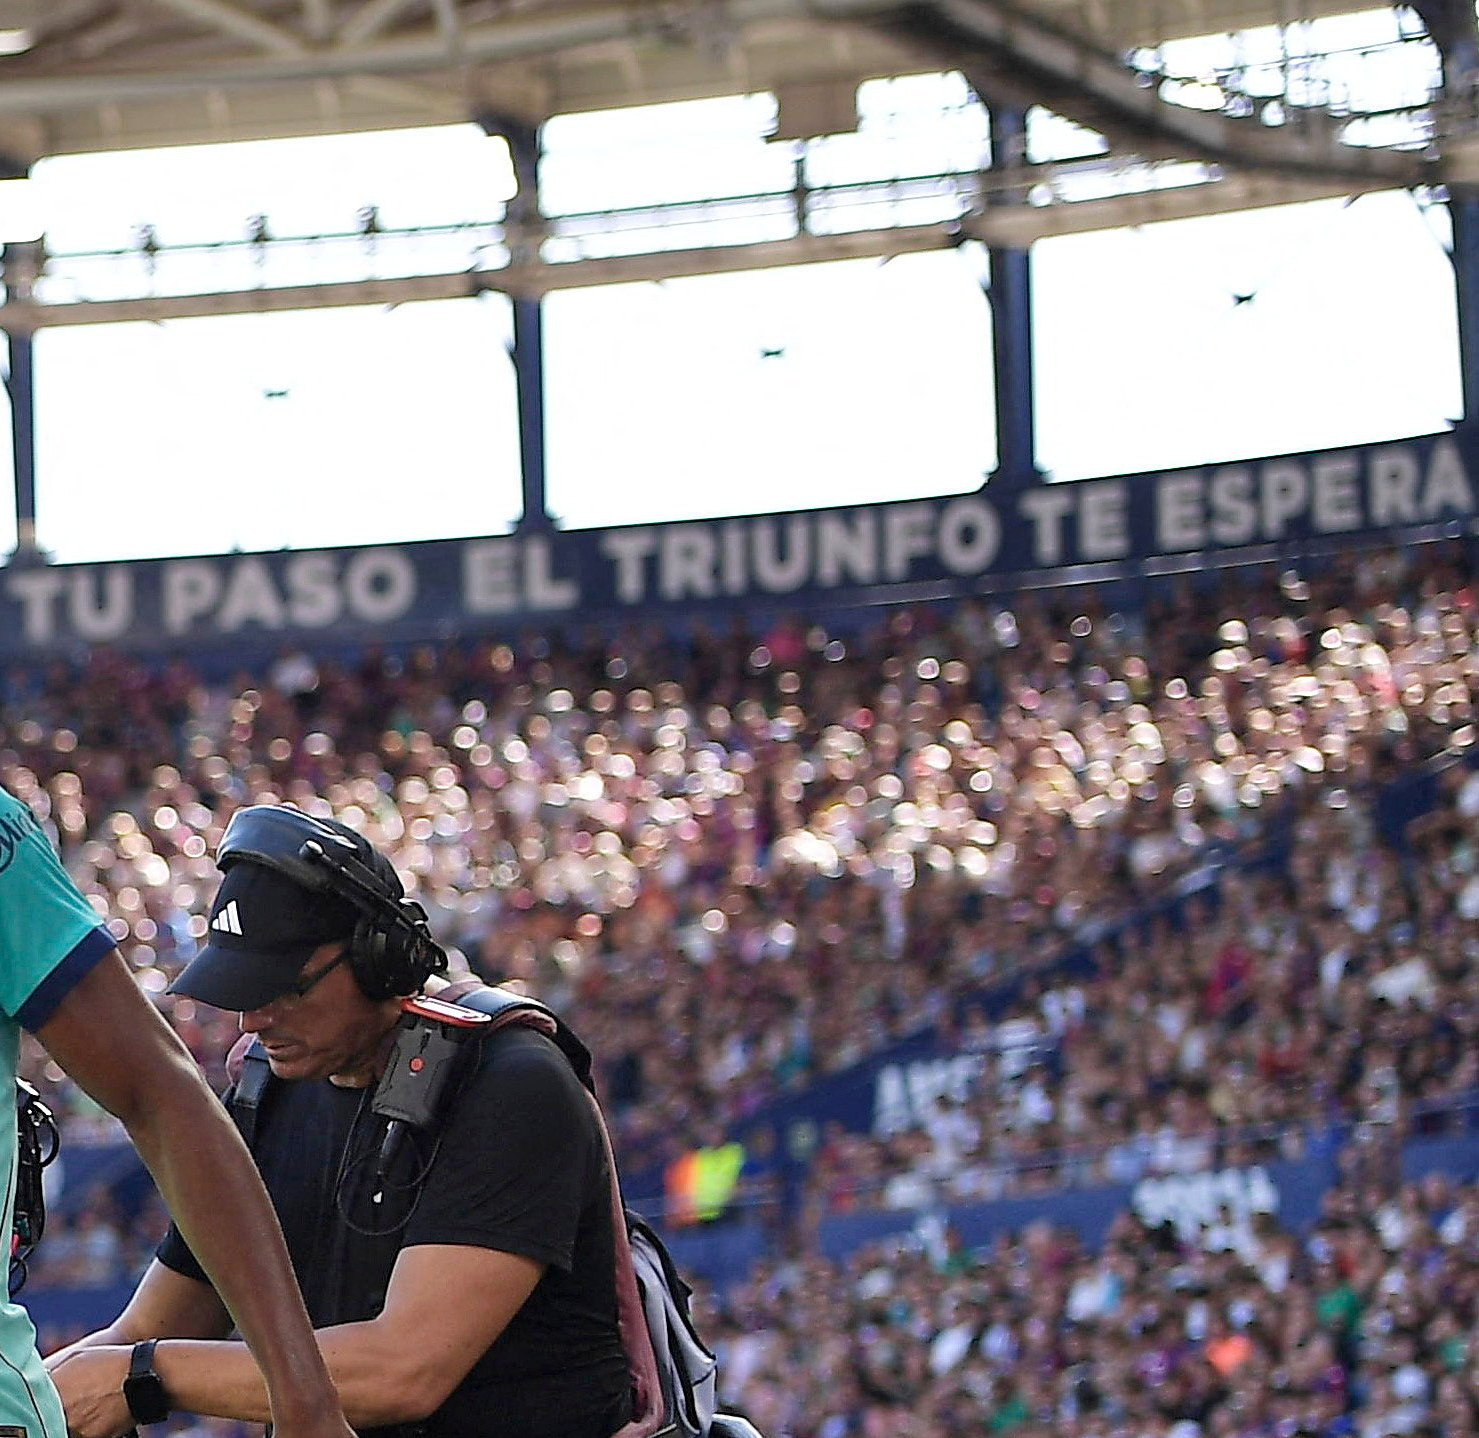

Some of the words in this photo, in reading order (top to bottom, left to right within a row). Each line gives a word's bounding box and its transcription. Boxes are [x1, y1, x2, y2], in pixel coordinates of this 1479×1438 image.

[7, 567, 131, 641] TU
[162, 547, 417, 635] PASO
[462, 535, 580, 613] EL
[600, 499, 1003, 602] TRIUNFO
[1020, 481, 1130, 564] TE
[1154, 437, 1475, 552] ESPERA
